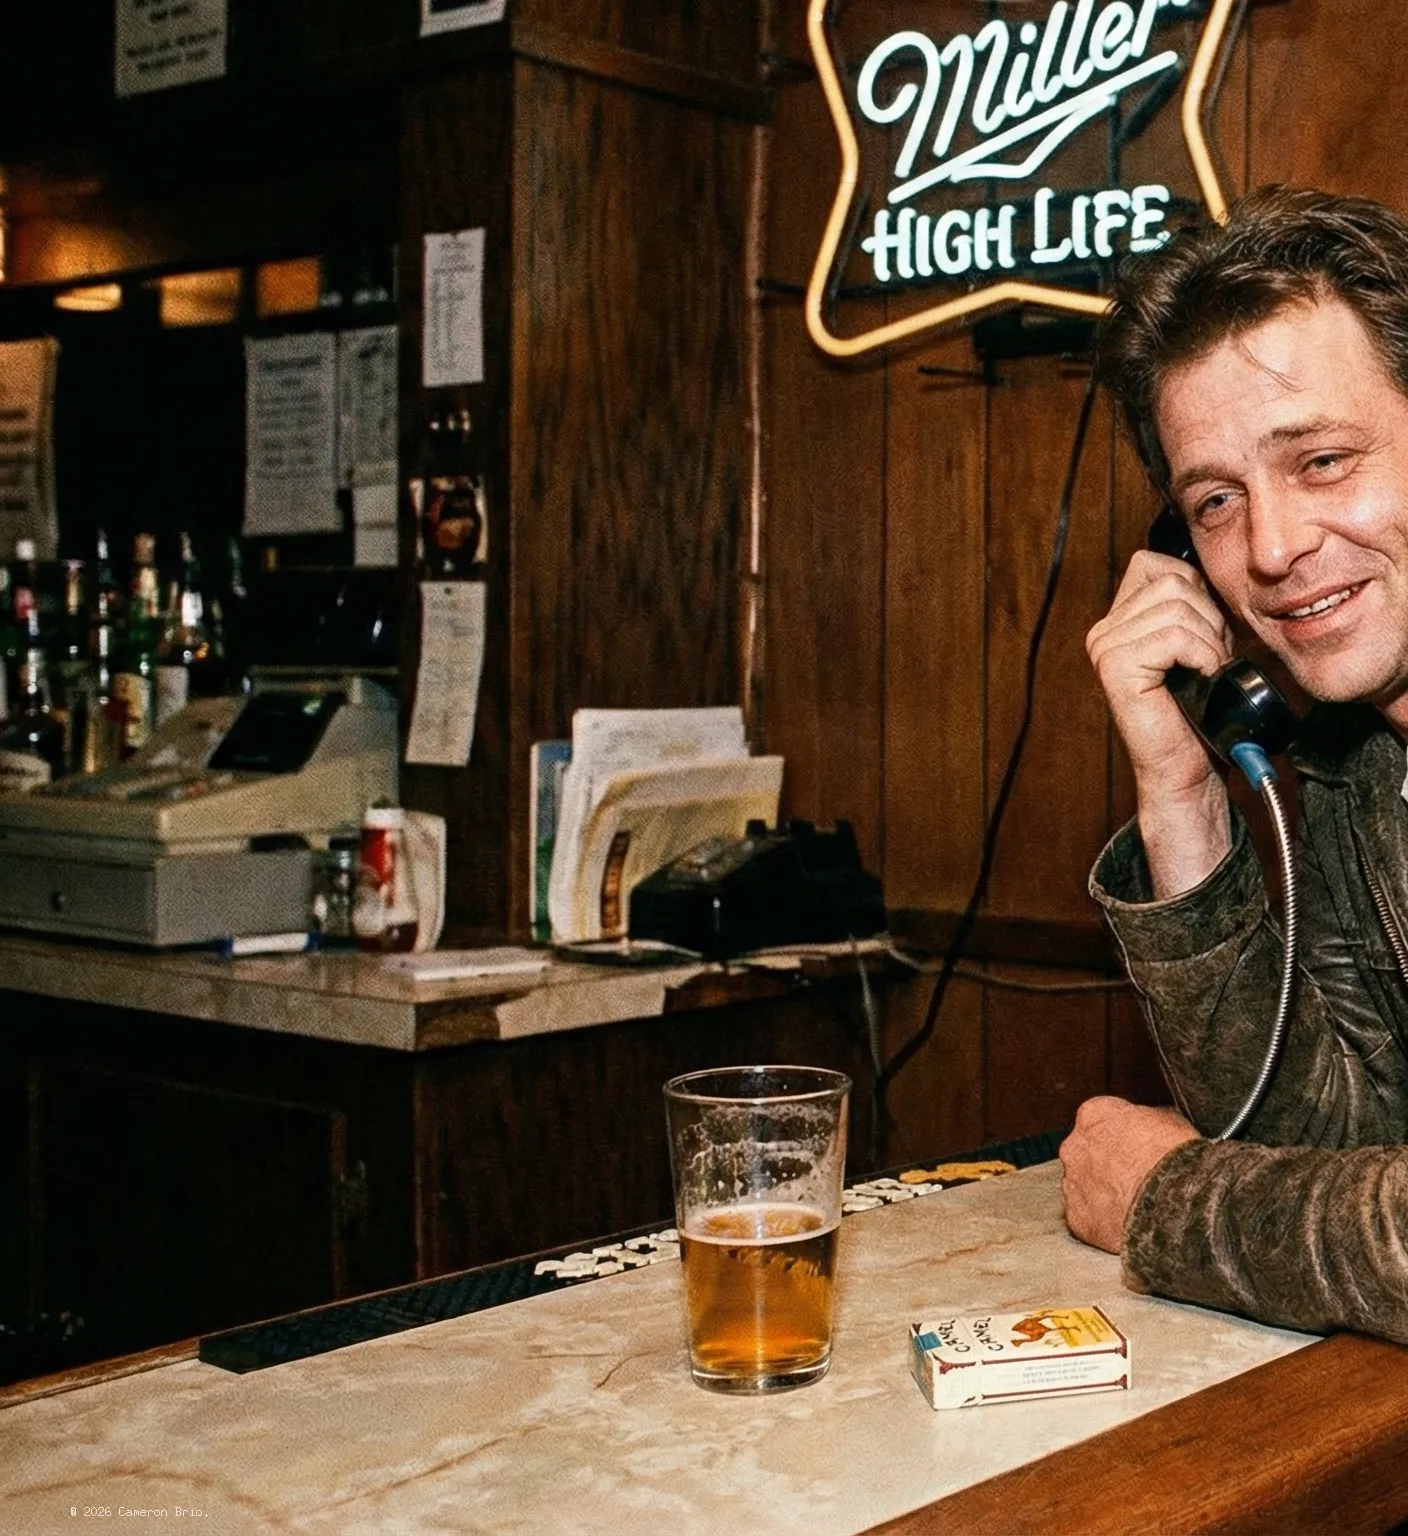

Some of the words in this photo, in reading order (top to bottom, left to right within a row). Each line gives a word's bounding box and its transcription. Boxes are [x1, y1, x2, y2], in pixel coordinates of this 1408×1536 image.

[857, 0, 1191, 178] Miller
[861, 205, 1017, 282] HIGH
[1030, 186, 1171, 264] LIFE
[938, 1319, 971, 1353] CAMEL
[973, 1317, 1004, 1352] CAMEL
